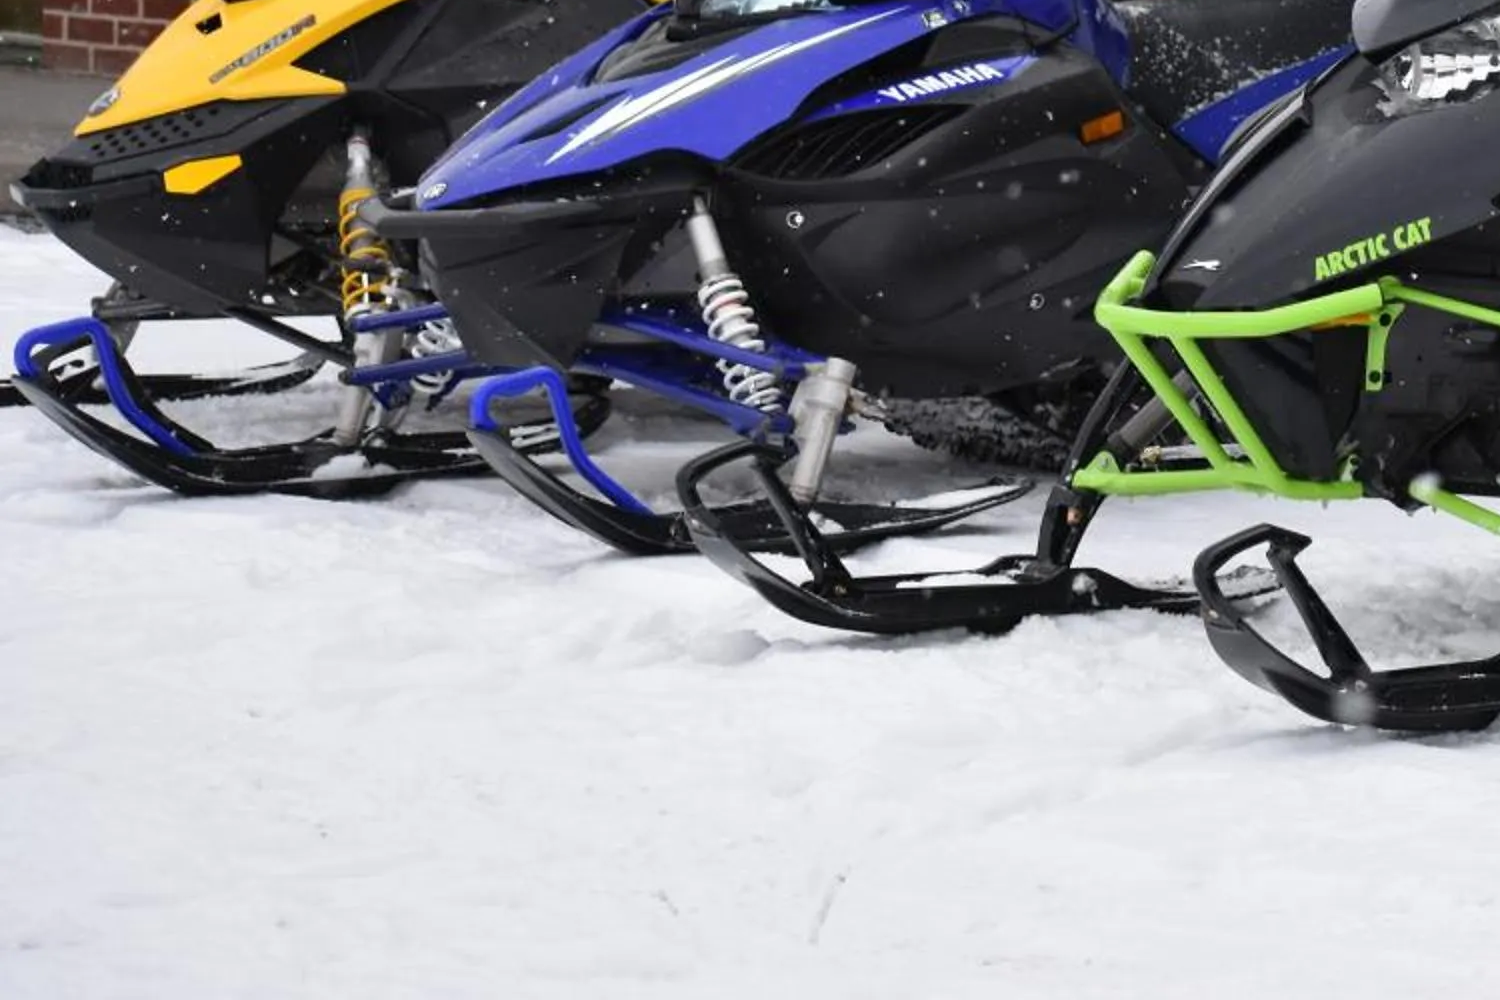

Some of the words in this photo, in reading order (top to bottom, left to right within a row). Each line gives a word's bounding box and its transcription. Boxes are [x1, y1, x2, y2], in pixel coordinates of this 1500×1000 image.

[877, 63, 1004, 101] YAMAHA
[1315, 232, 1391, 281] ARCTIC
[1393, 216, 1431, 250] CAT
